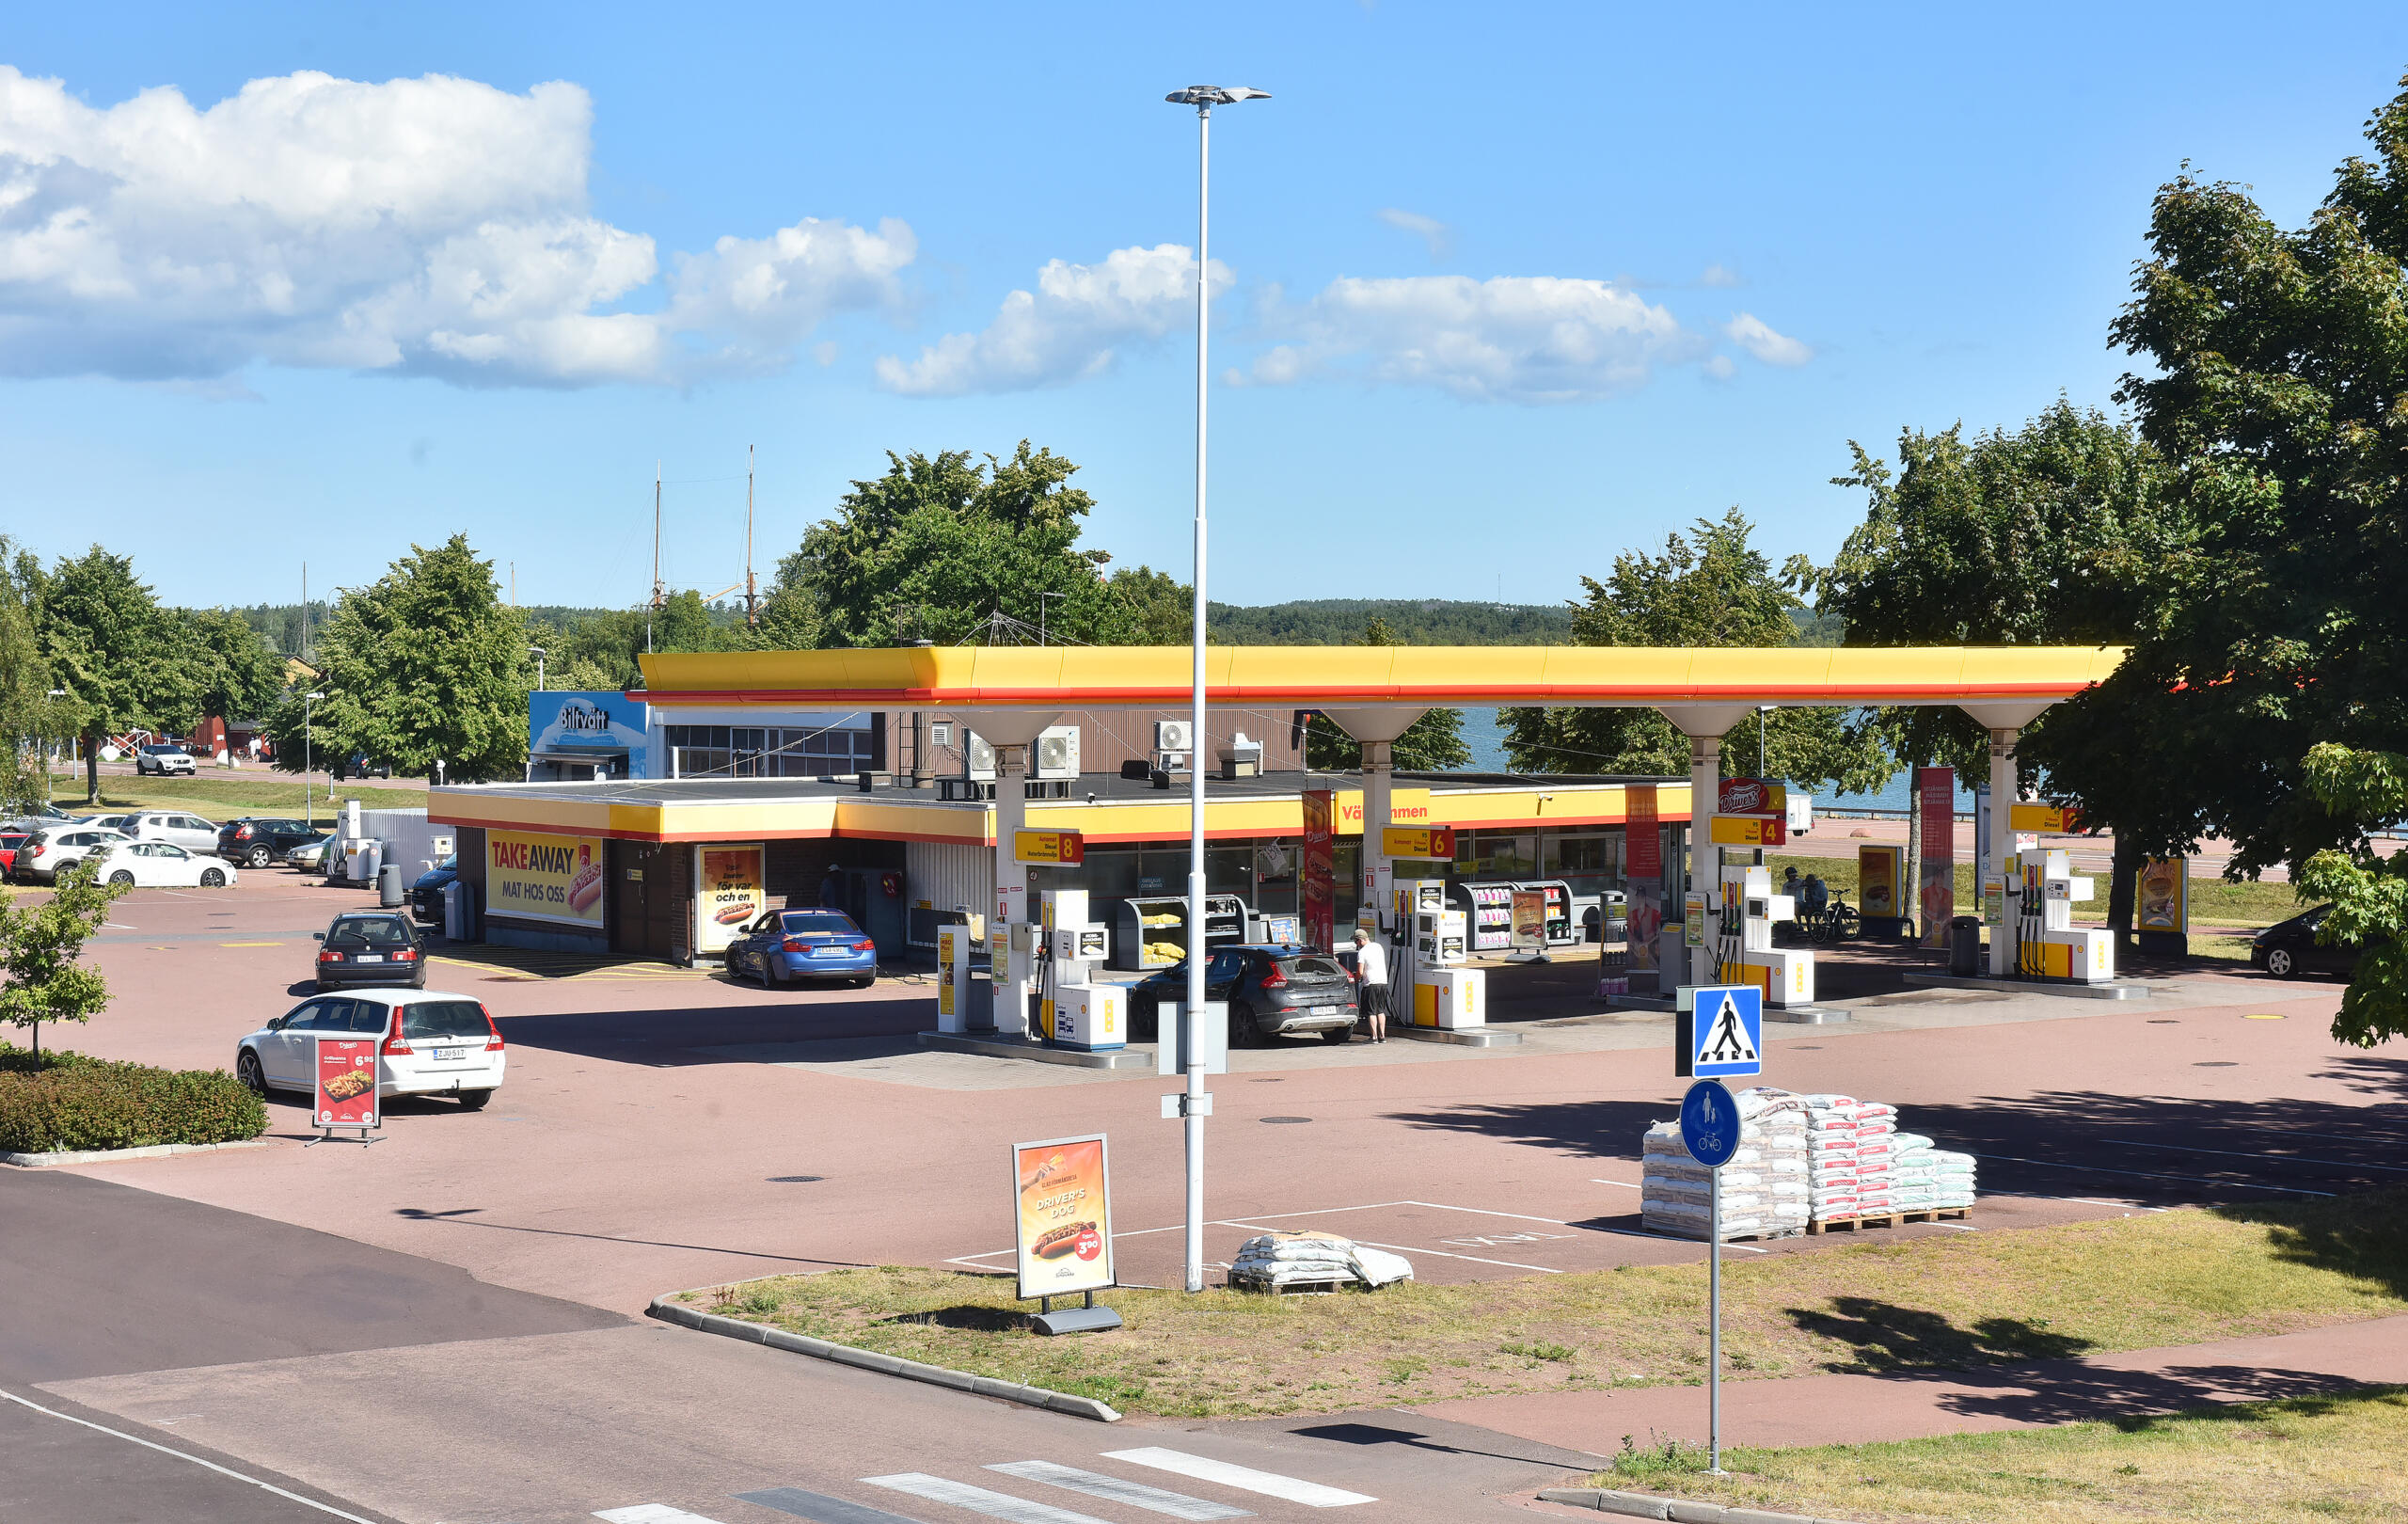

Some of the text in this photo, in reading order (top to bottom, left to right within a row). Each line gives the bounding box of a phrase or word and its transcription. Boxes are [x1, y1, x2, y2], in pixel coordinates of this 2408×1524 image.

[560, 706, 610, 729] Biltvätt
[1766, 823, 1776, 841] 4
[1064, 838, 1073, 857] 8
[1434, 834, 1445, 853] 6
[502, 881, 564, 903] MAT HOS OSS
[717, 881, 752, 891] för var
[716, 893, 751, 902] och en
[1037, 1188, 1085, 1211] DRIVER'S
[1052, 1205, 1075, 1219] DOG
